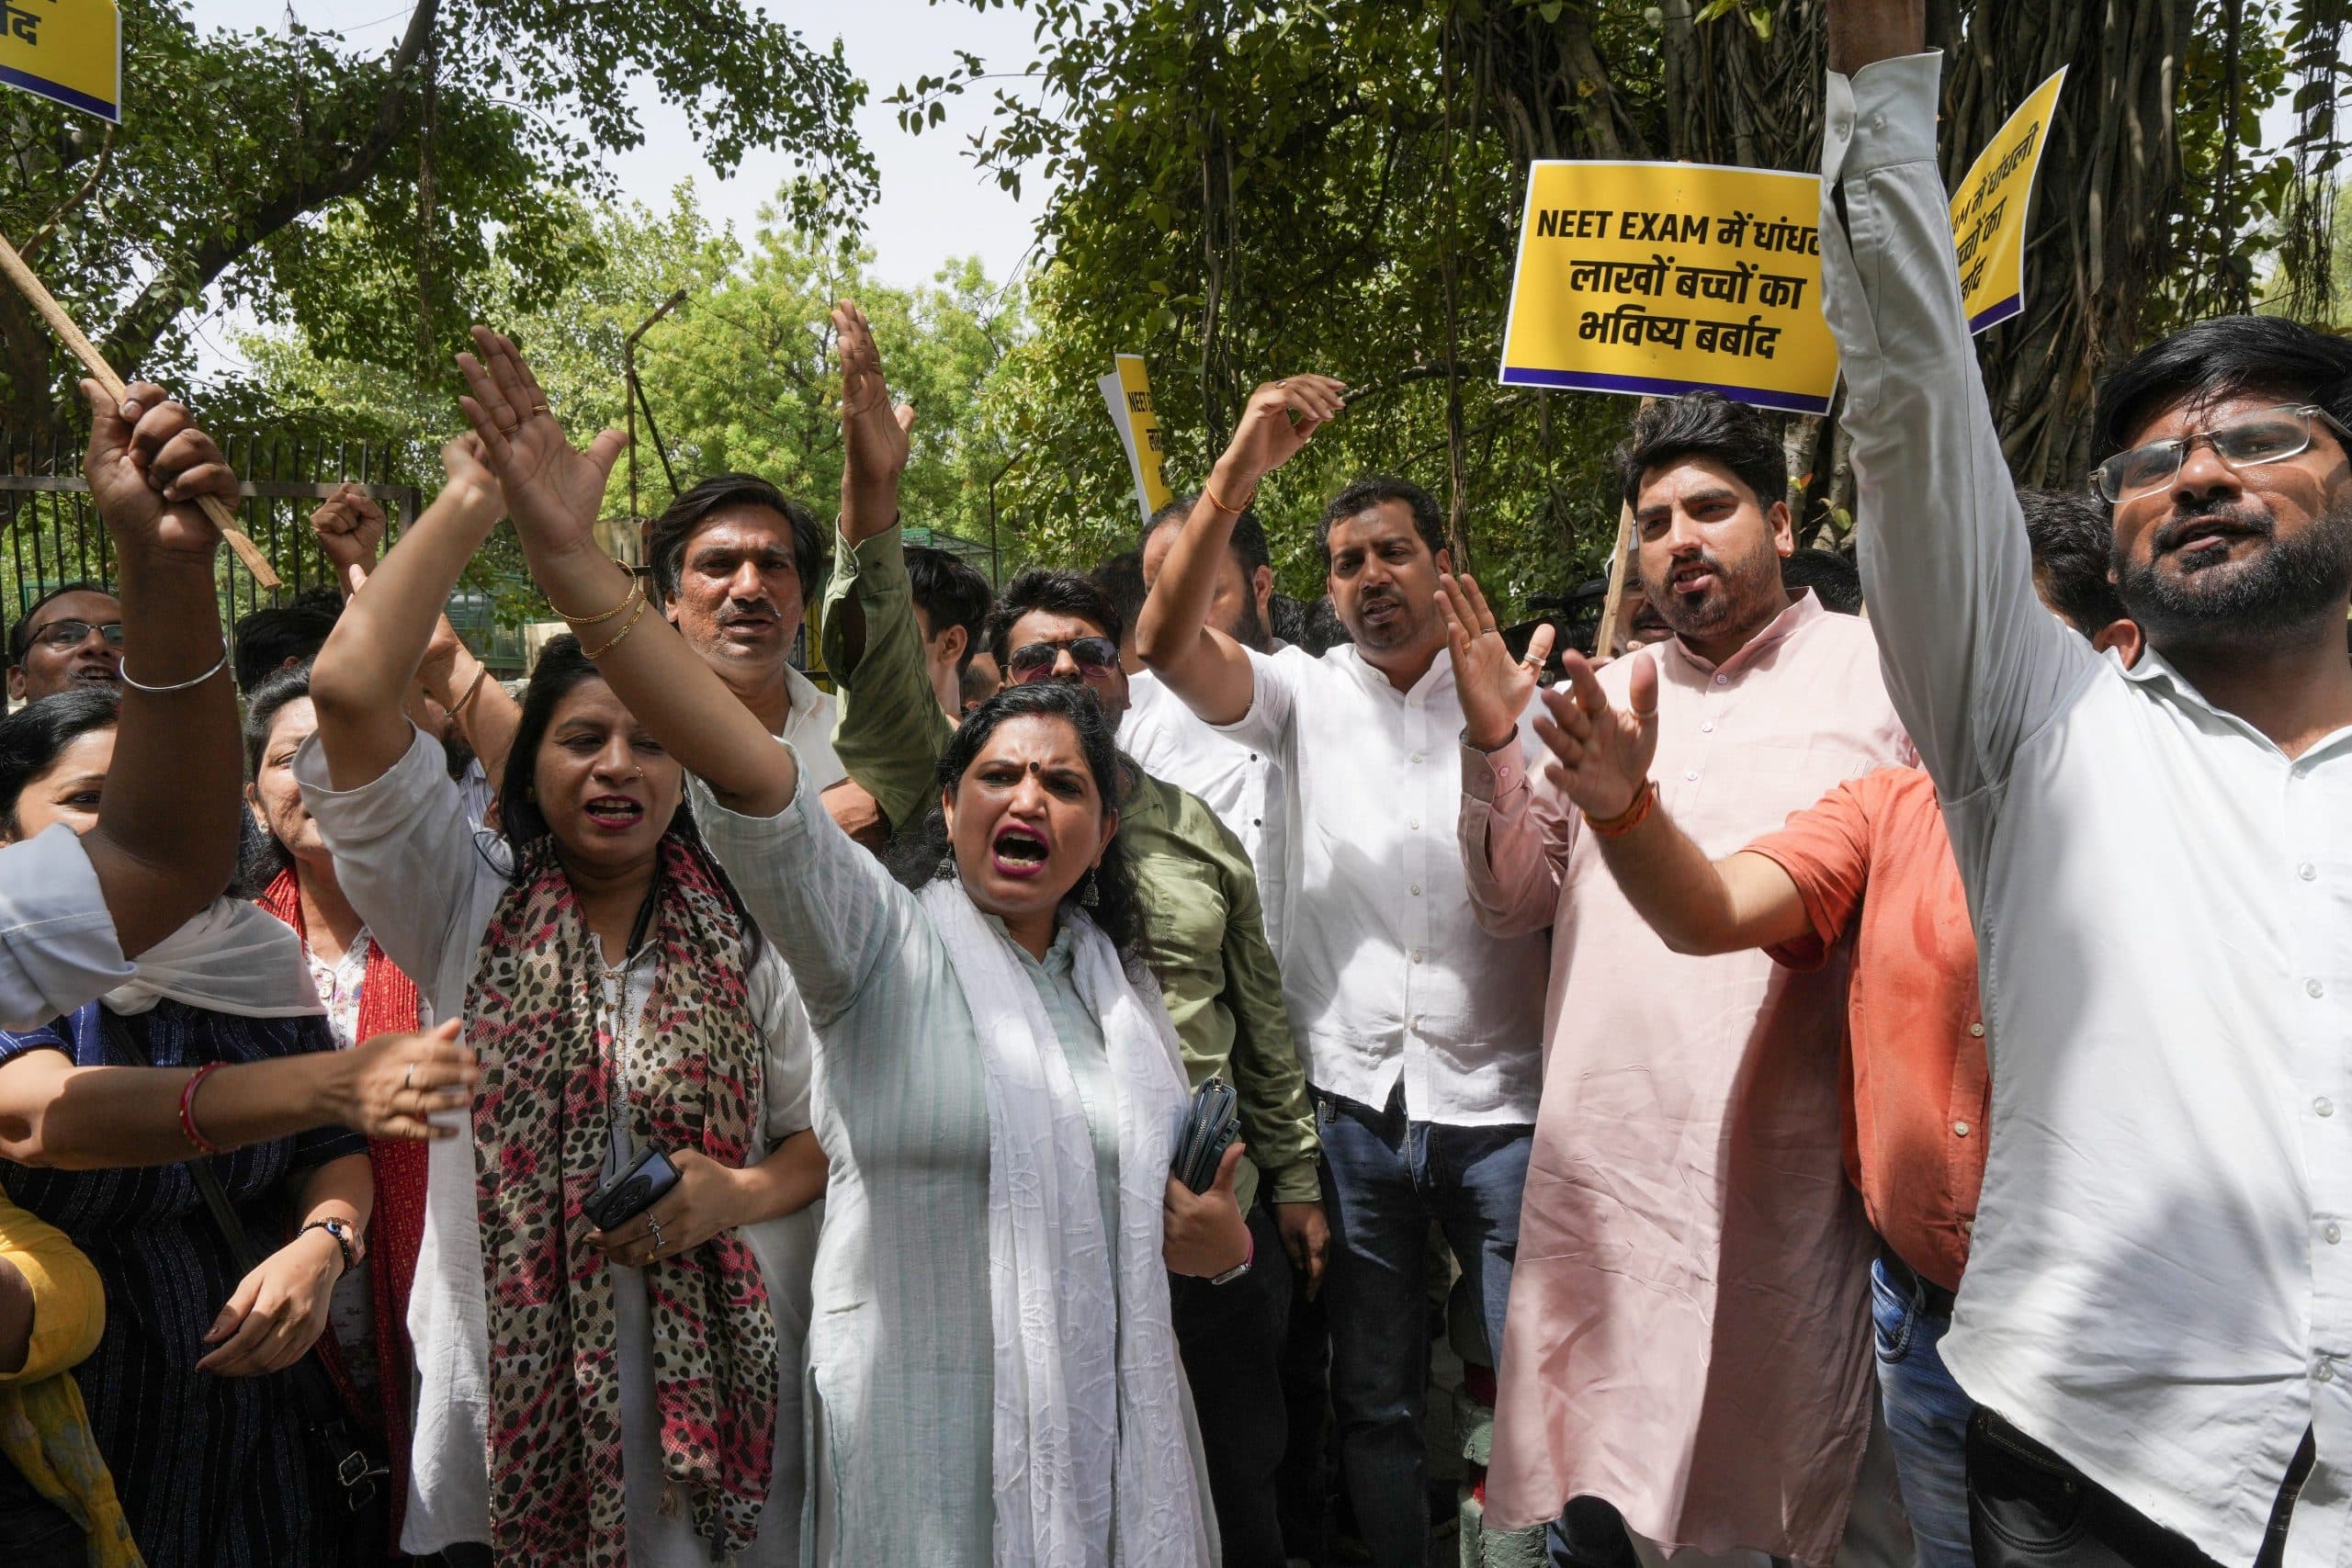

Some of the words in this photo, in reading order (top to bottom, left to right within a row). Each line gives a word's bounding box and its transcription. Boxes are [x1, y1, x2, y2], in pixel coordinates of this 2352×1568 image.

[1987, 120, 2040, 197] धांधली
[1536, 209, 1613, 239] NEET
[1619, 210, 1710, 245] EXAM
[1716, 210, 1754, 248] में
[1569, 254, 1676, 297] लाखों
[1675, 261, 1759, 304] बच्चों
[1758, 275, 1808, 310] का
[1578, 304, 1690, 350] भविष्य
[1695, 315, 1782, 360] बर्बाद
[1127, 391, 1148, 412] NEET
